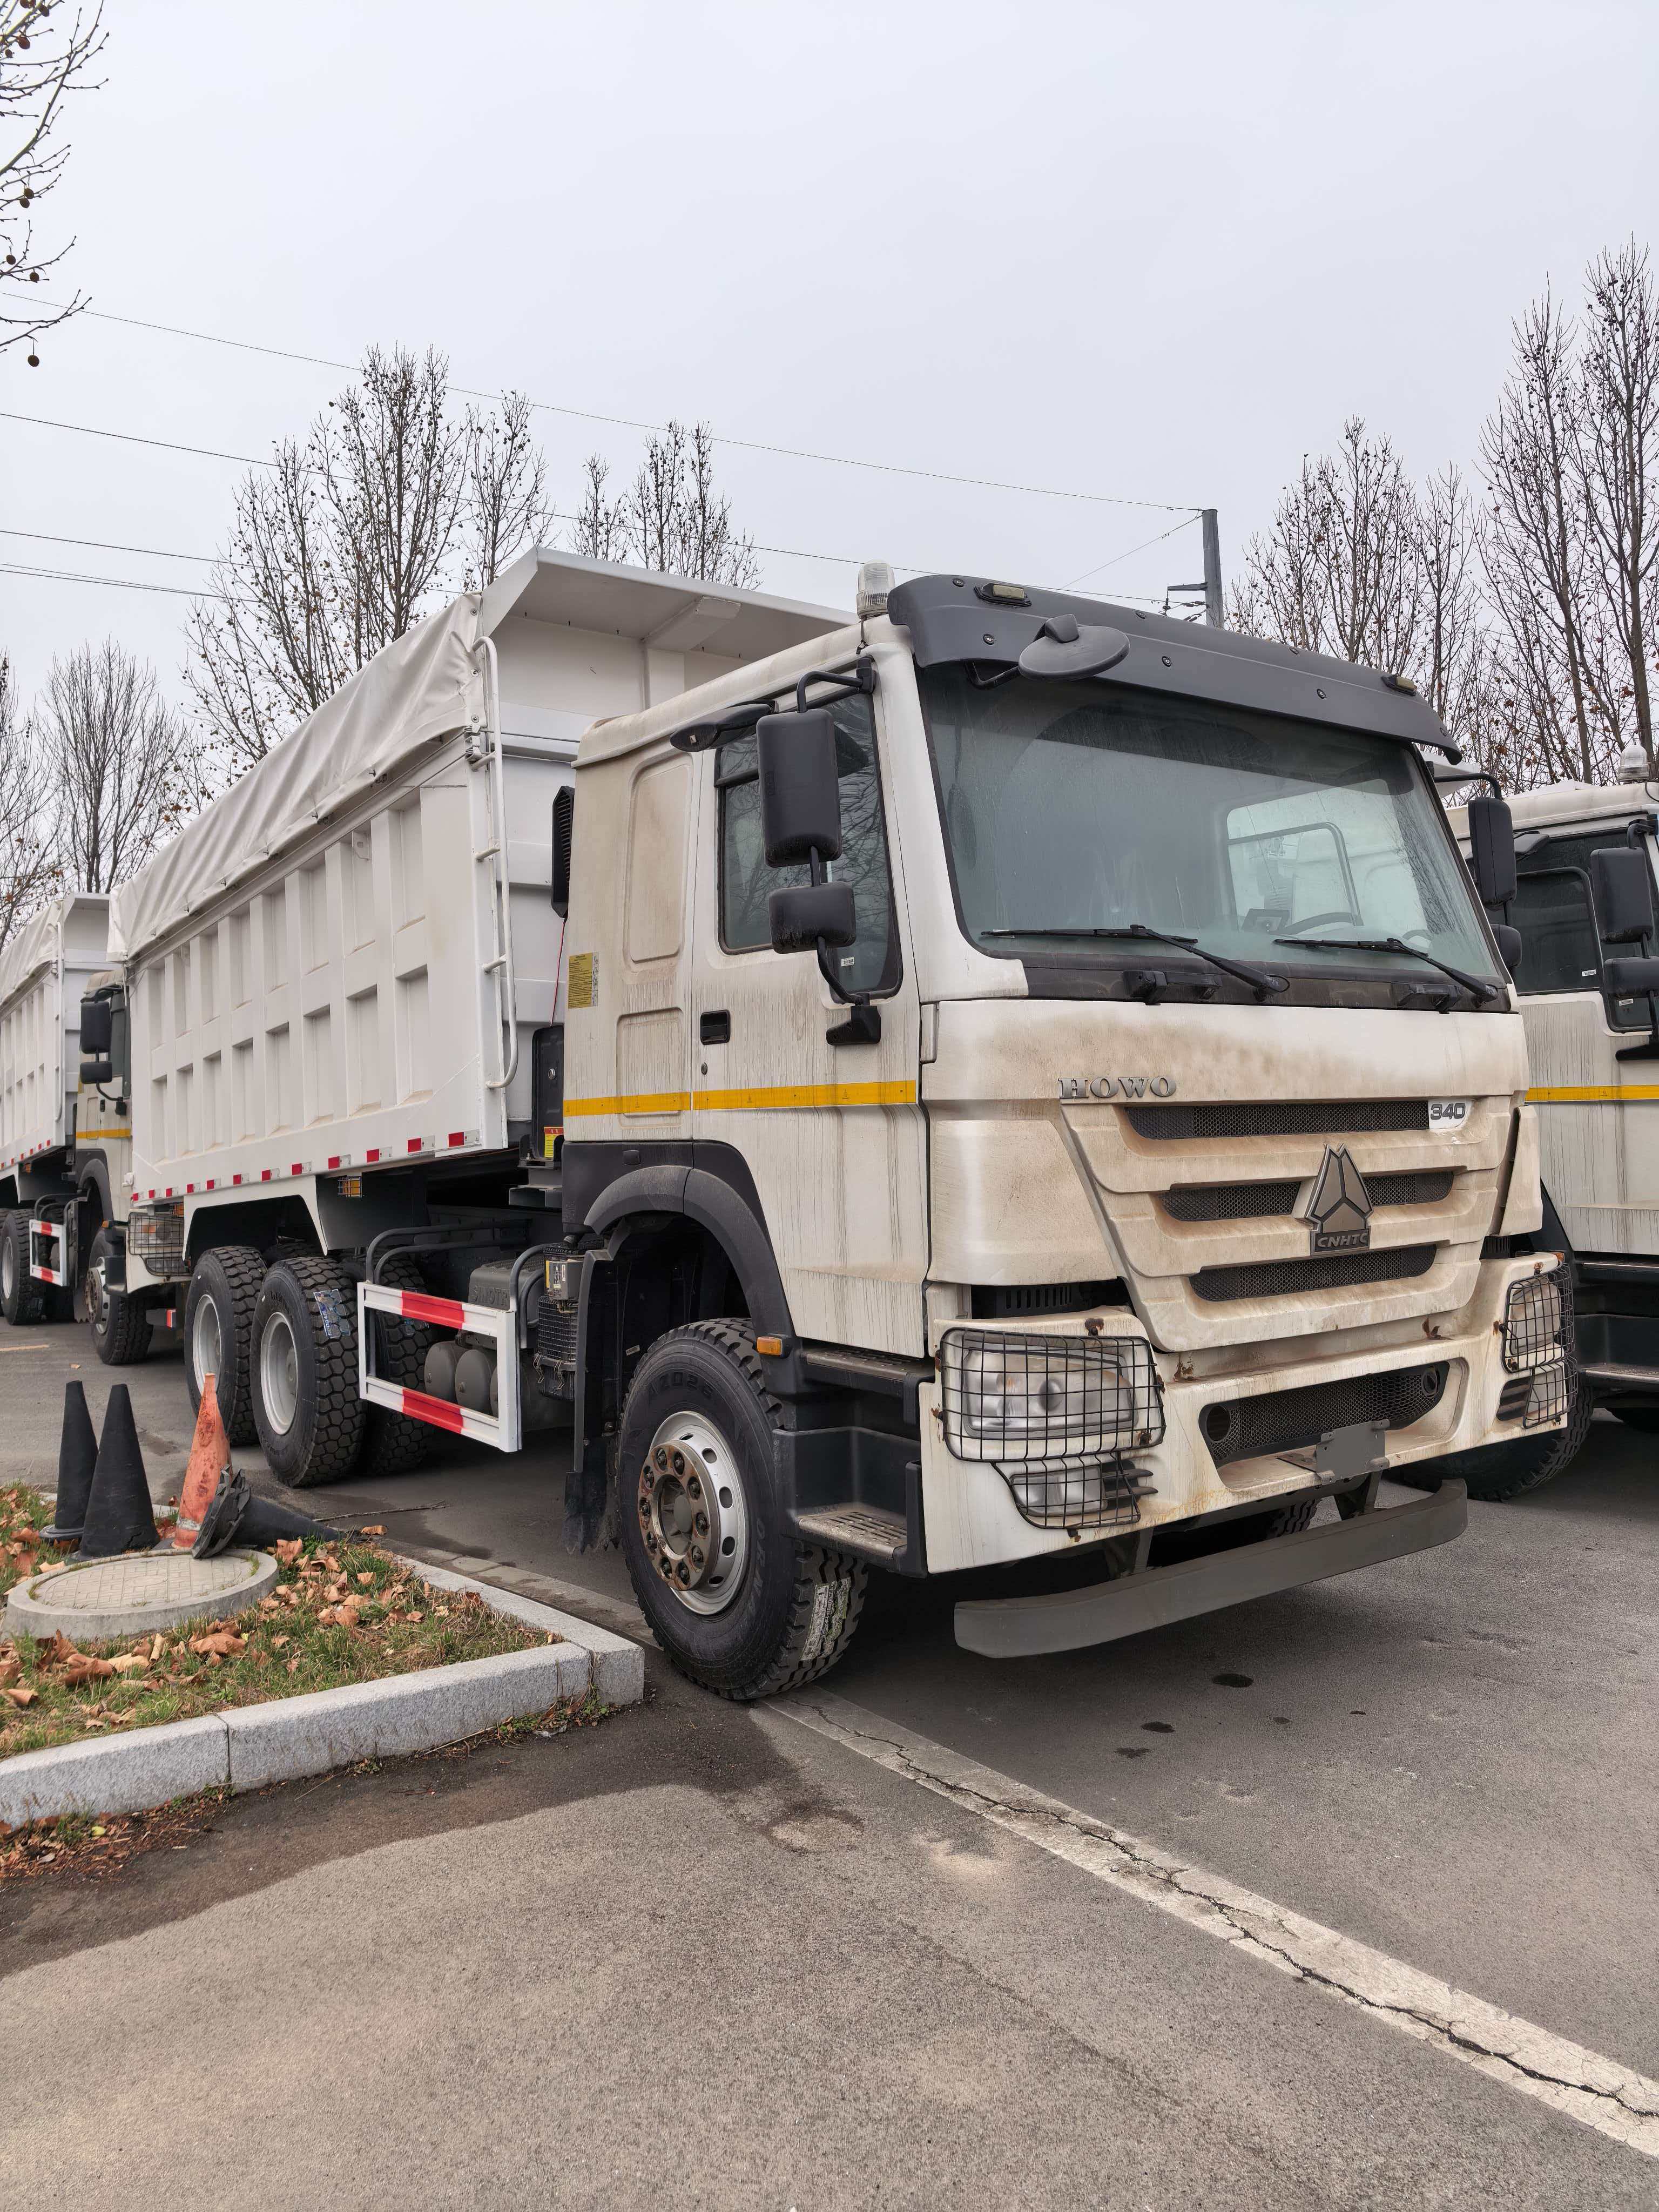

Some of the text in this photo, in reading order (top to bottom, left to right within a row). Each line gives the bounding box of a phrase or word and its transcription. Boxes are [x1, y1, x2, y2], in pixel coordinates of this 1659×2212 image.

[1058, 1076, 1177, 1099] HOWO
[1430, 1102, 1466, 1121] 340
[1317, 1232, 1368, 1247] CNHTC
